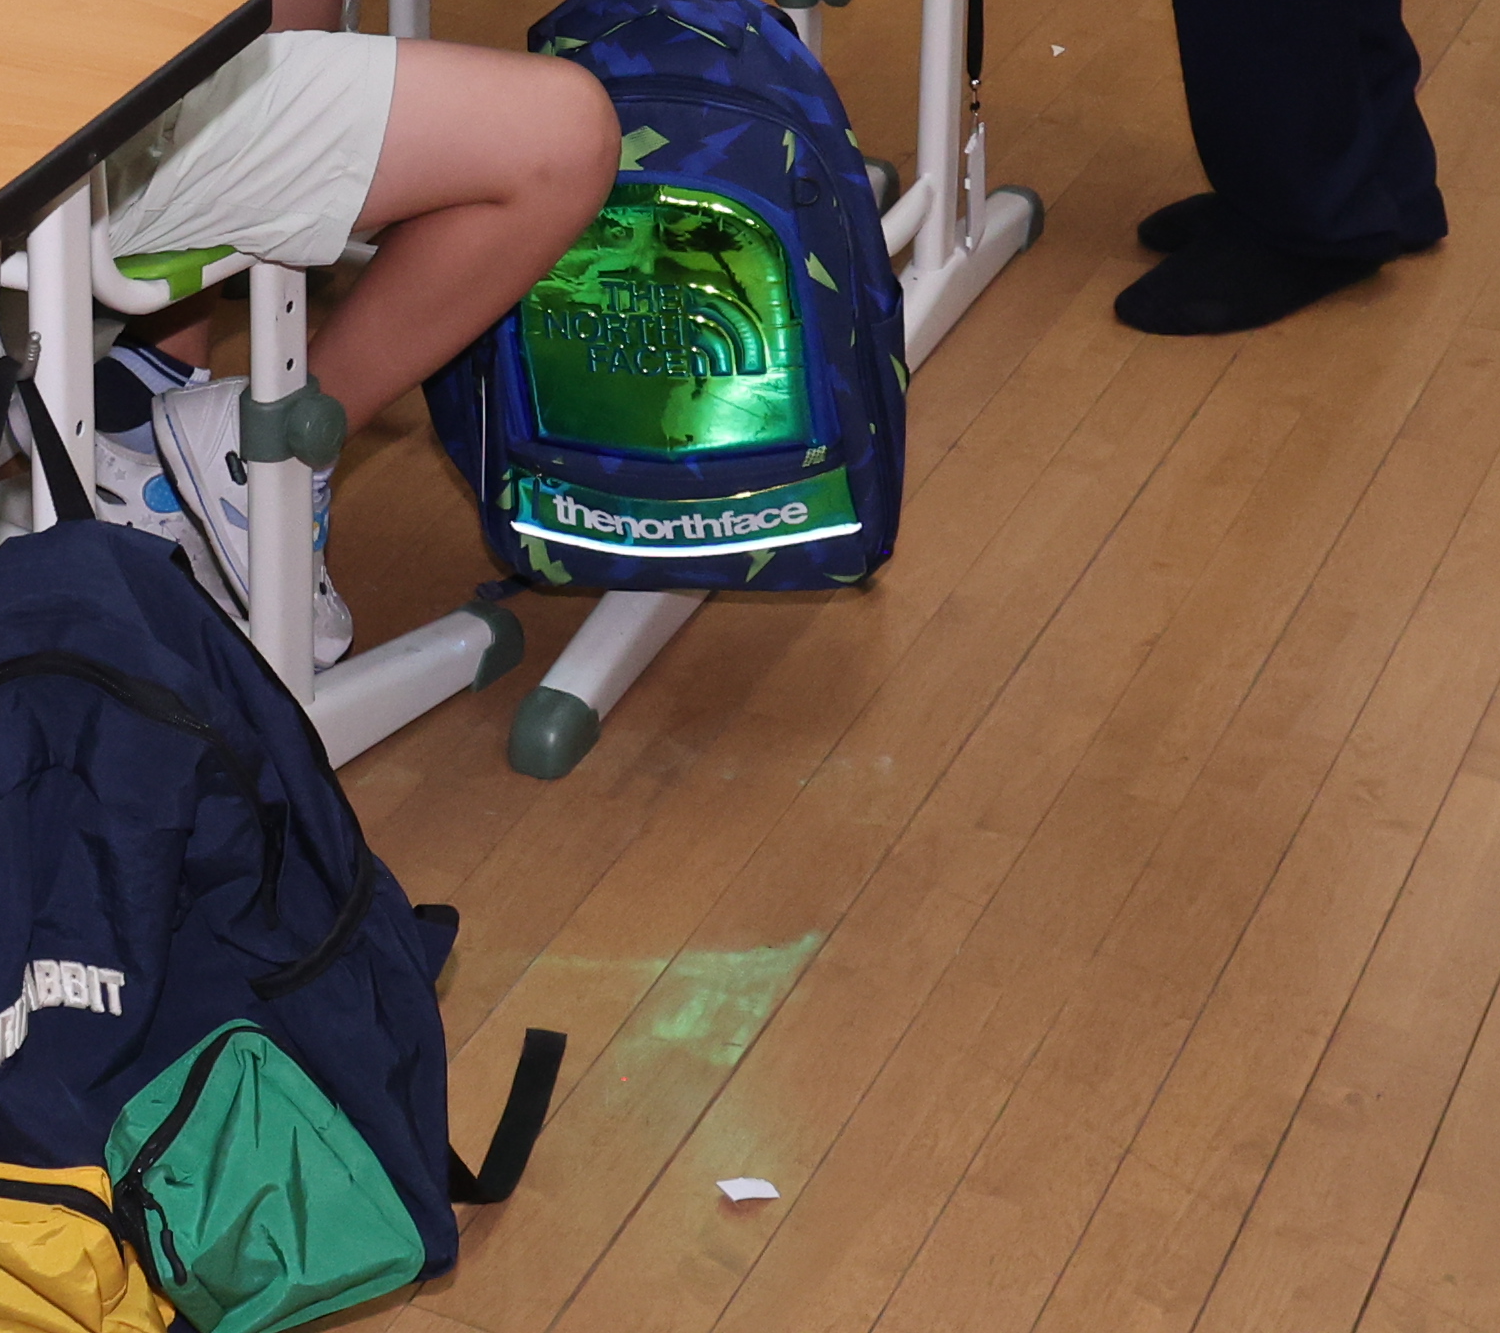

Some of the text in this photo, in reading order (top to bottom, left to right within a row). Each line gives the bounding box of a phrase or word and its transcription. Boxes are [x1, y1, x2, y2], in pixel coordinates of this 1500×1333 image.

[603, 279, 682, 315] THE
[545, 309, 685, 347] NORTH
[587, 345, 690, 377] FACE
[552, 493, 809, 540] thenorthface
